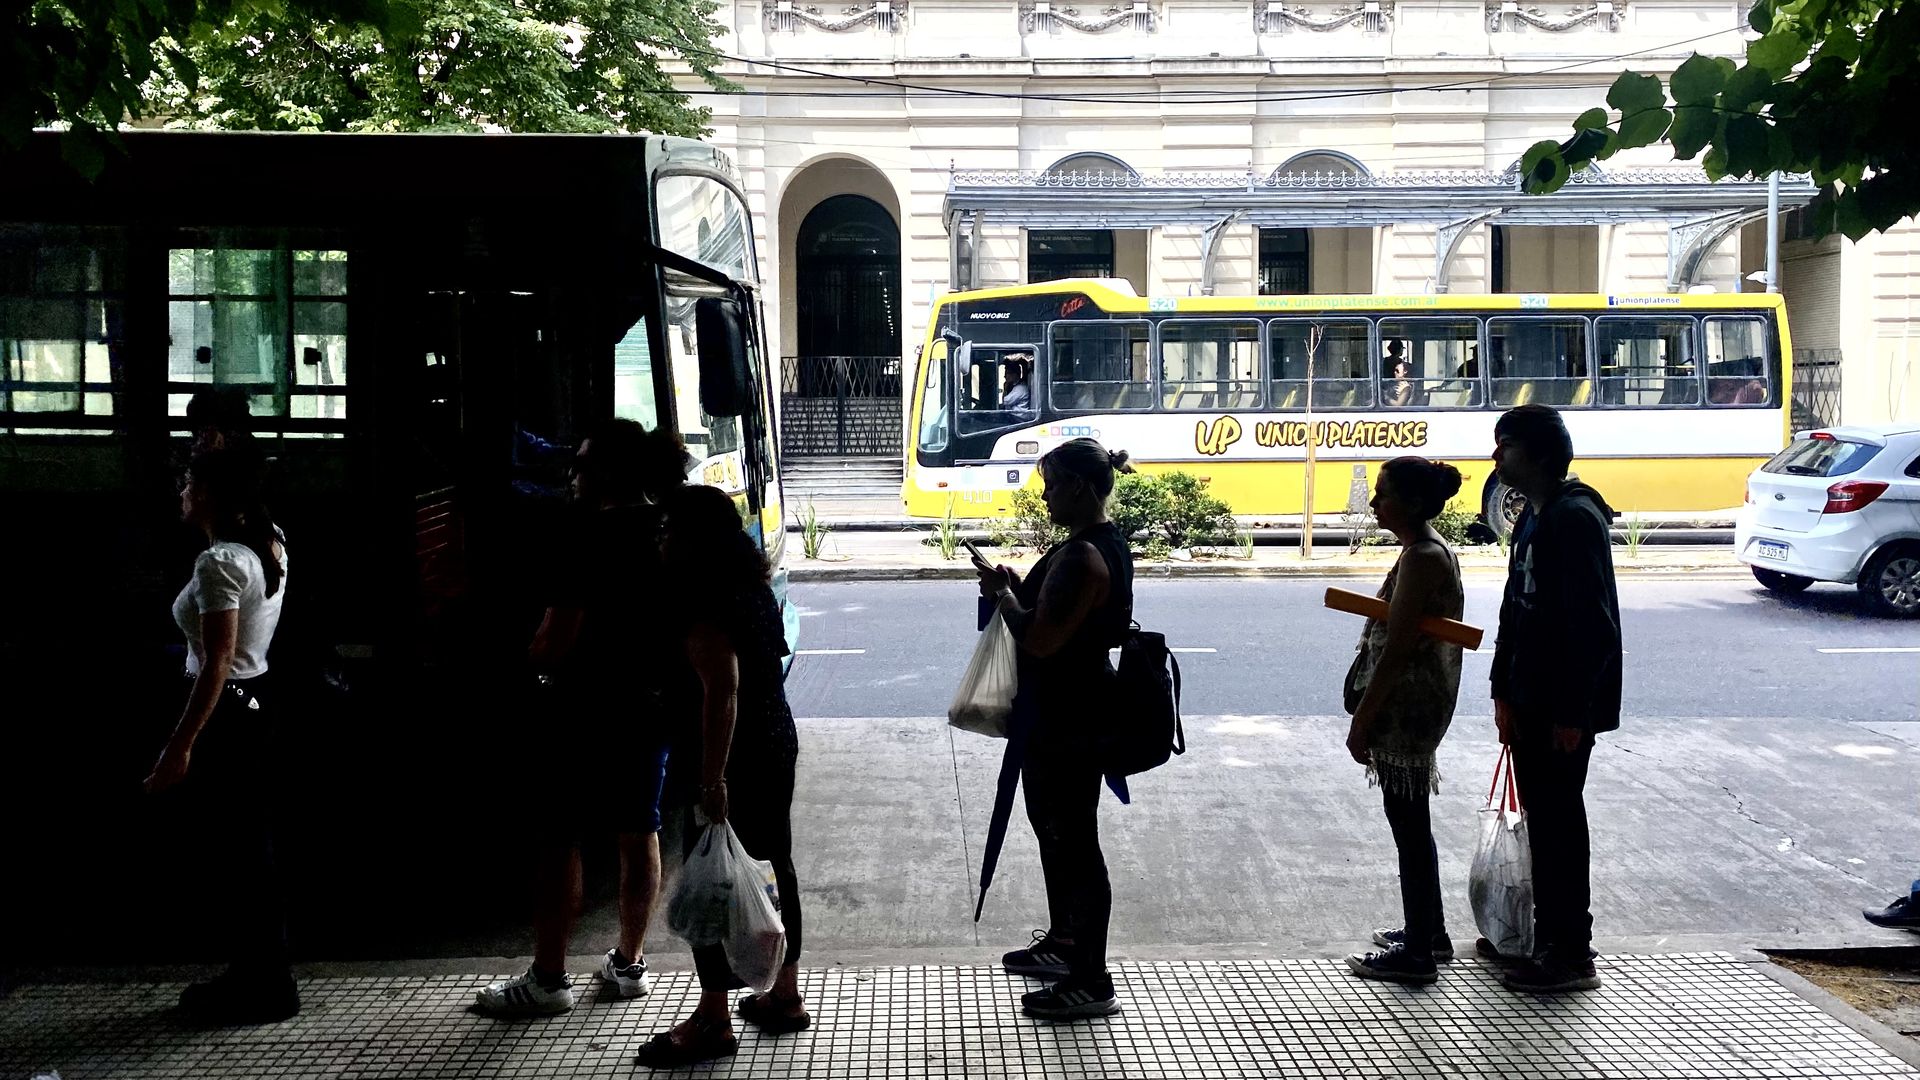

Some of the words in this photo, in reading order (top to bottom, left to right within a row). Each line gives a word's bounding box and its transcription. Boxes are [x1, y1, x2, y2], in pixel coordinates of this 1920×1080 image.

[1619, 297, 1680, 305] unionplatense
[1195, 415, 1242, 456] UP
[1256, 421, 1326, 447] UNION
[1327, 421, 1427, 448] PLATENSE
